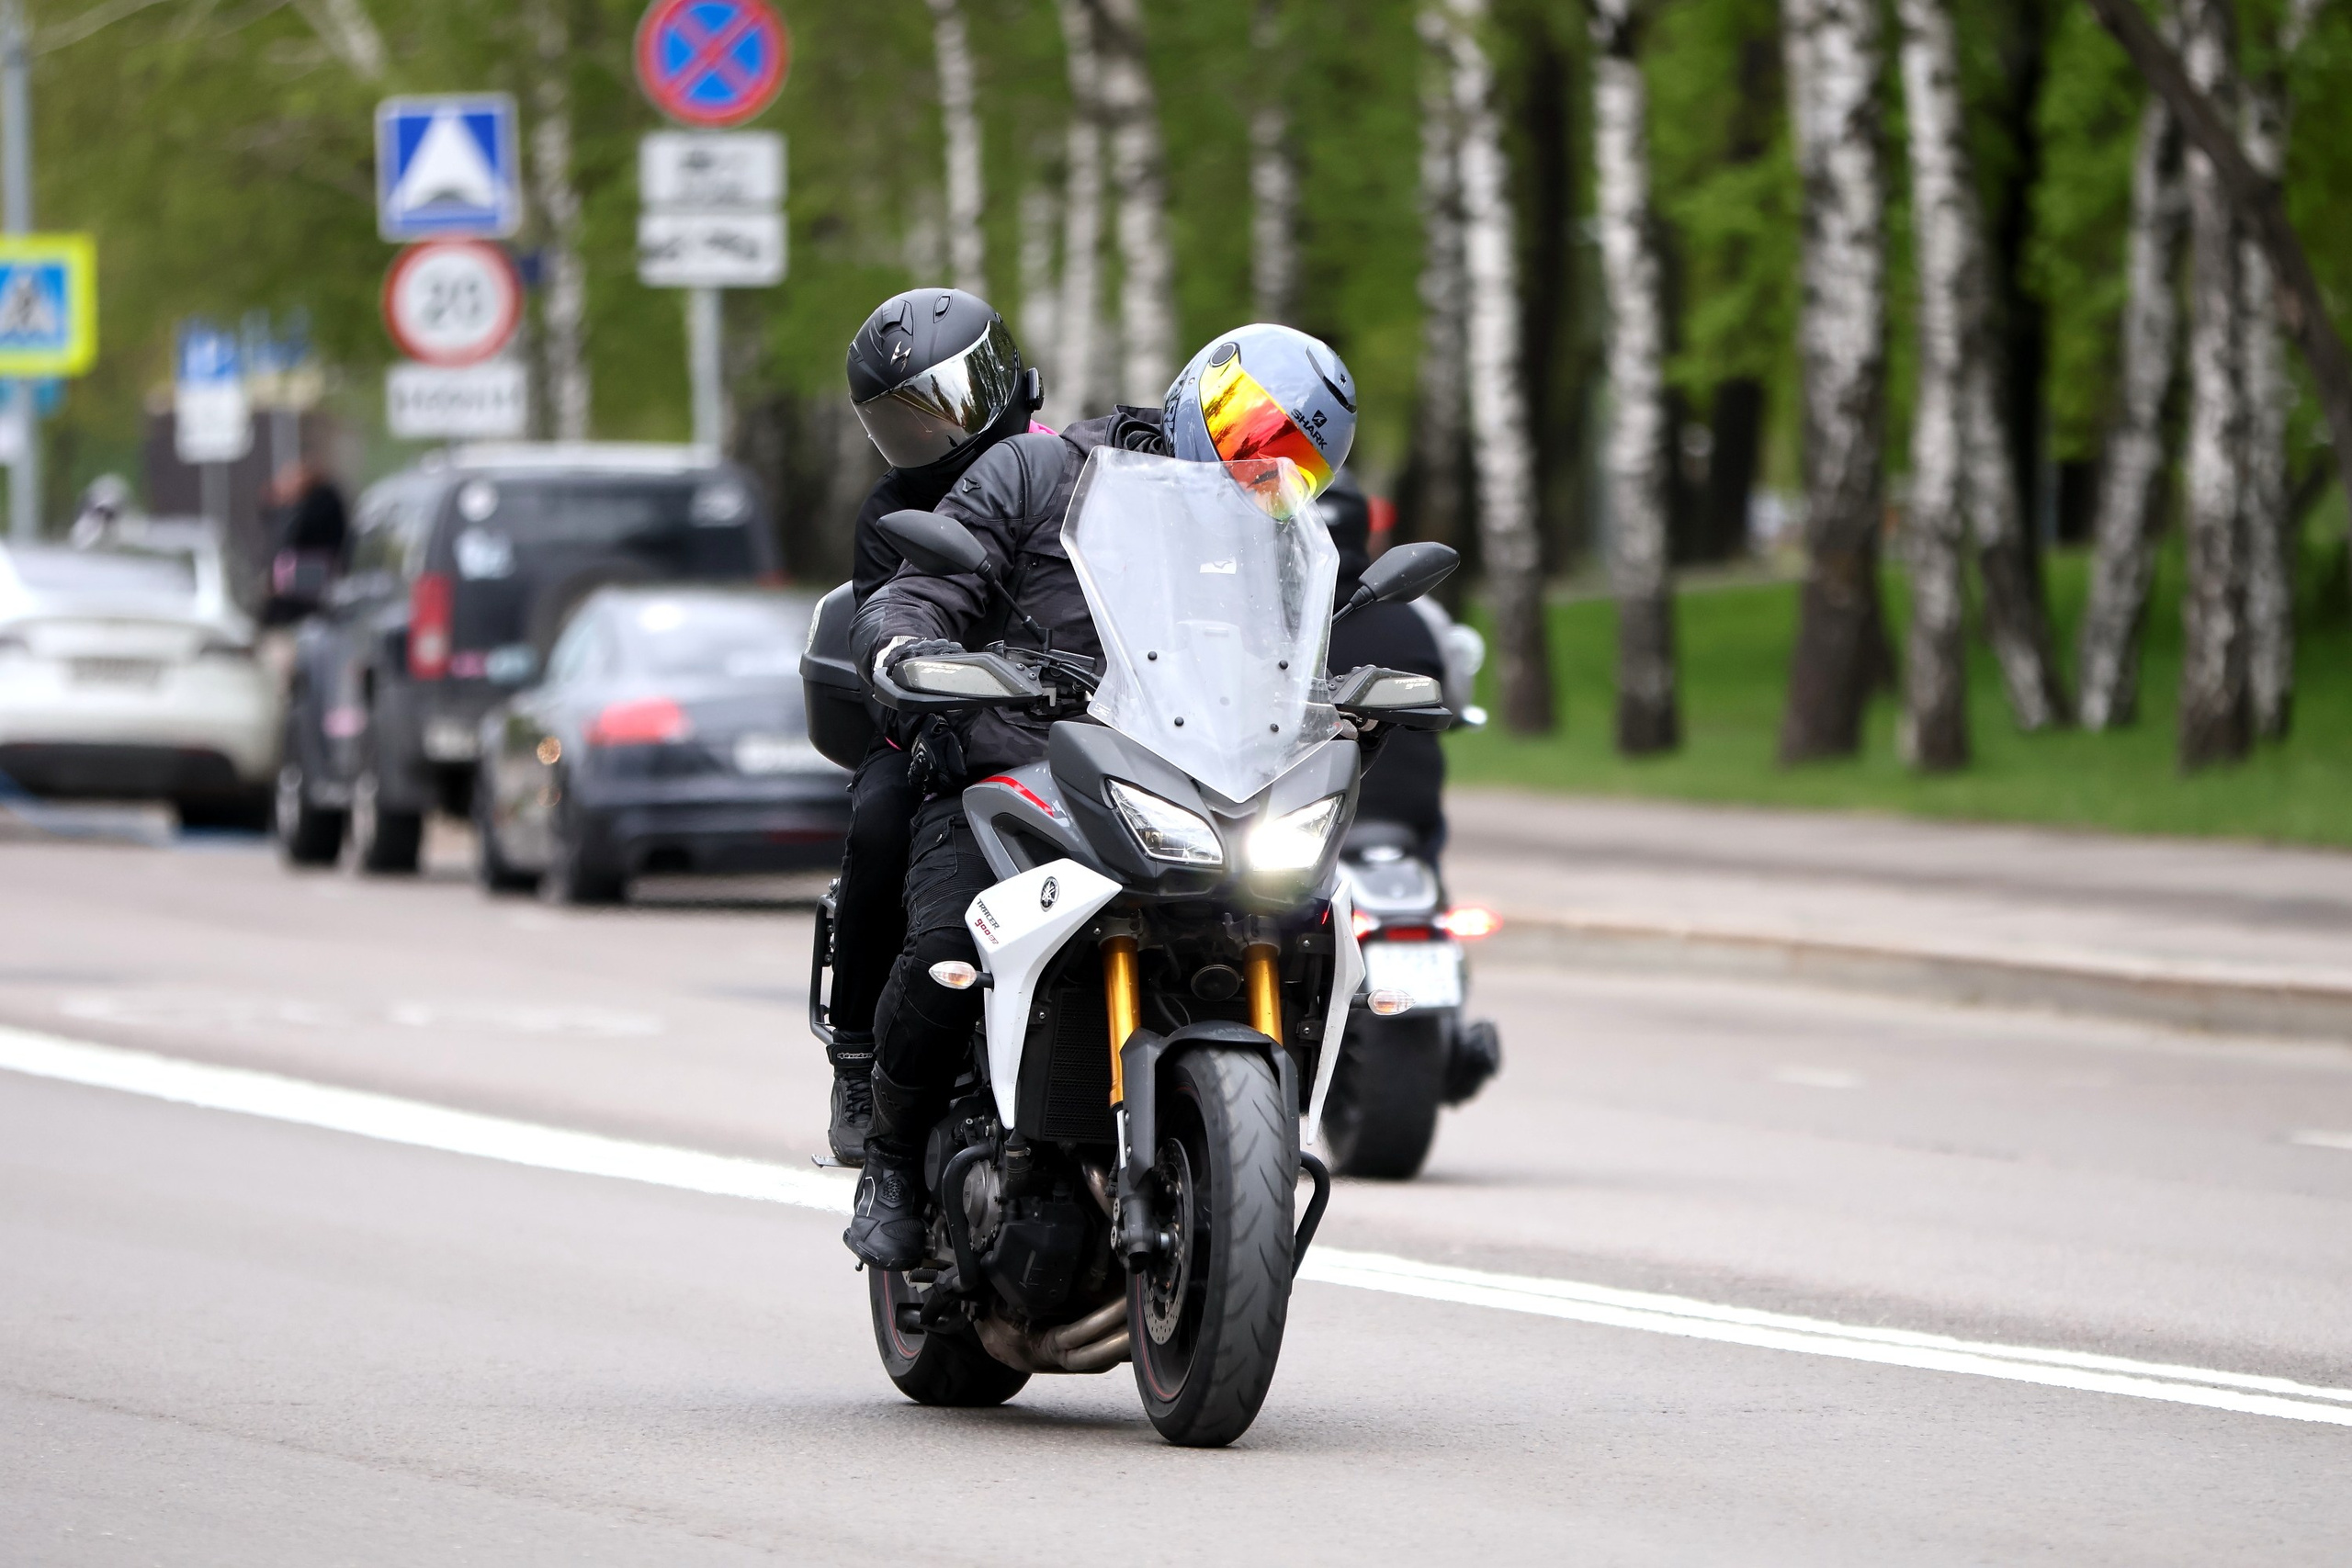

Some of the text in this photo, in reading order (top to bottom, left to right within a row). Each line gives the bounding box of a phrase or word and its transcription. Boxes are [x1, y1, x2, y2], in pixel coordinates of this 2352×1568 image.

[1291, 408, 1328, 450] SHARK
[974, 918, 991, 936] 900
[977, 897, 1001, 930] TRACER
